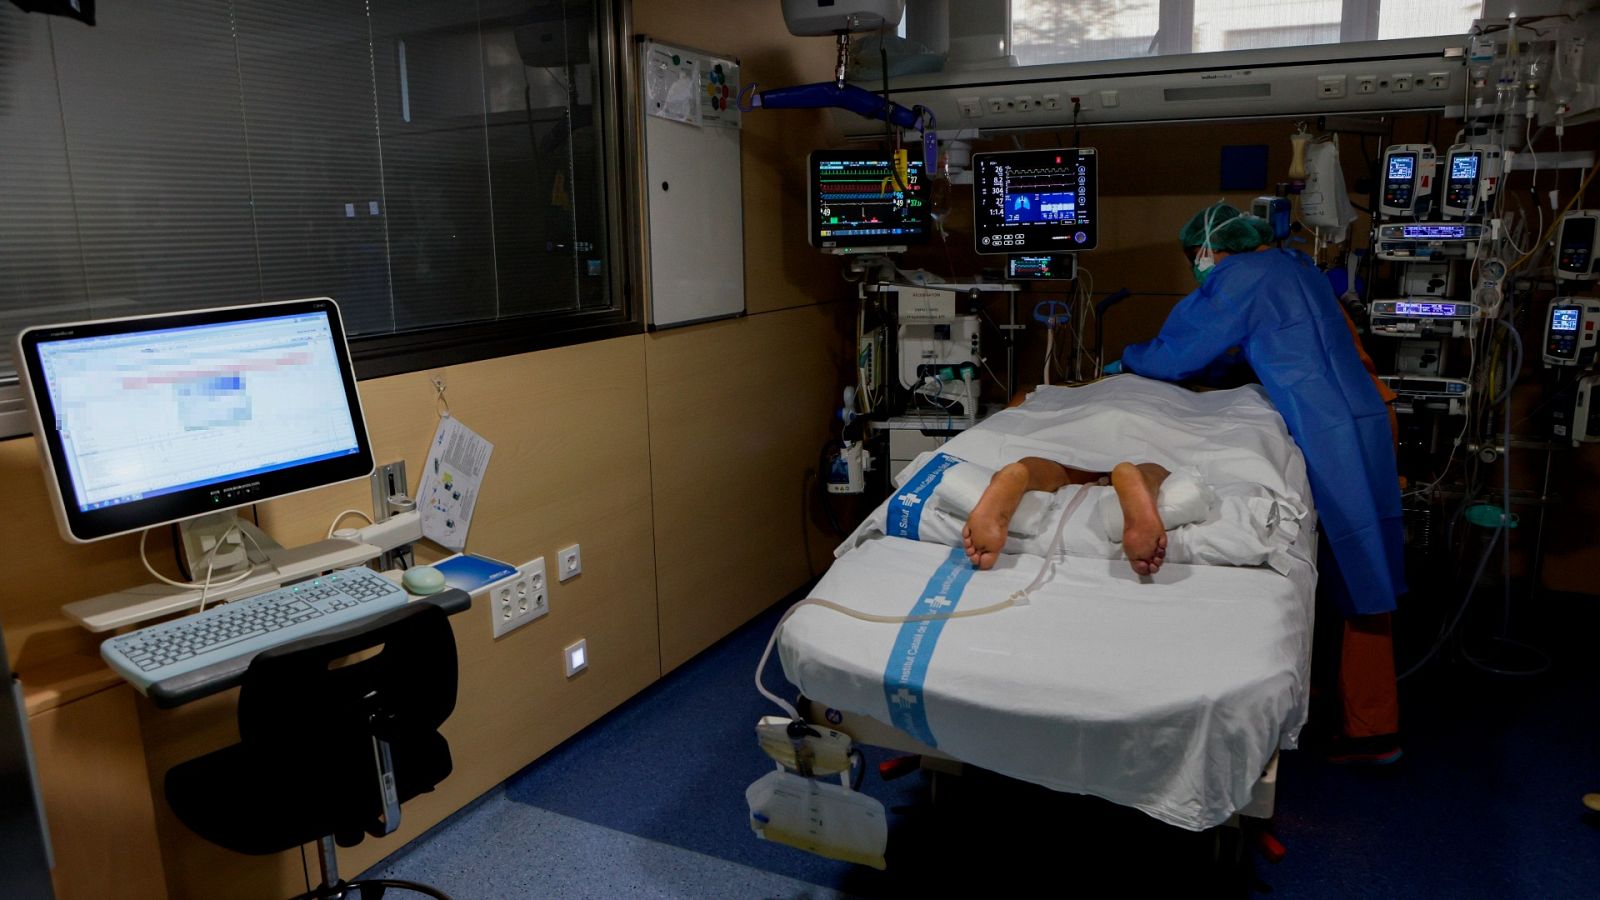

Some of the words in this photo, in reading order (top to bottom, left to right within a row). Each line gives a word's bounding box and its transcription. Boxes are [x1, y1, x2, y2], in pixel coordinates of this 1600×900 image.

[911, 176, 917, 184] 27
[896, 199, 904, 207] 49
[822, 208, 831, 216] 49
[899, 509, 910, 528] Salut
